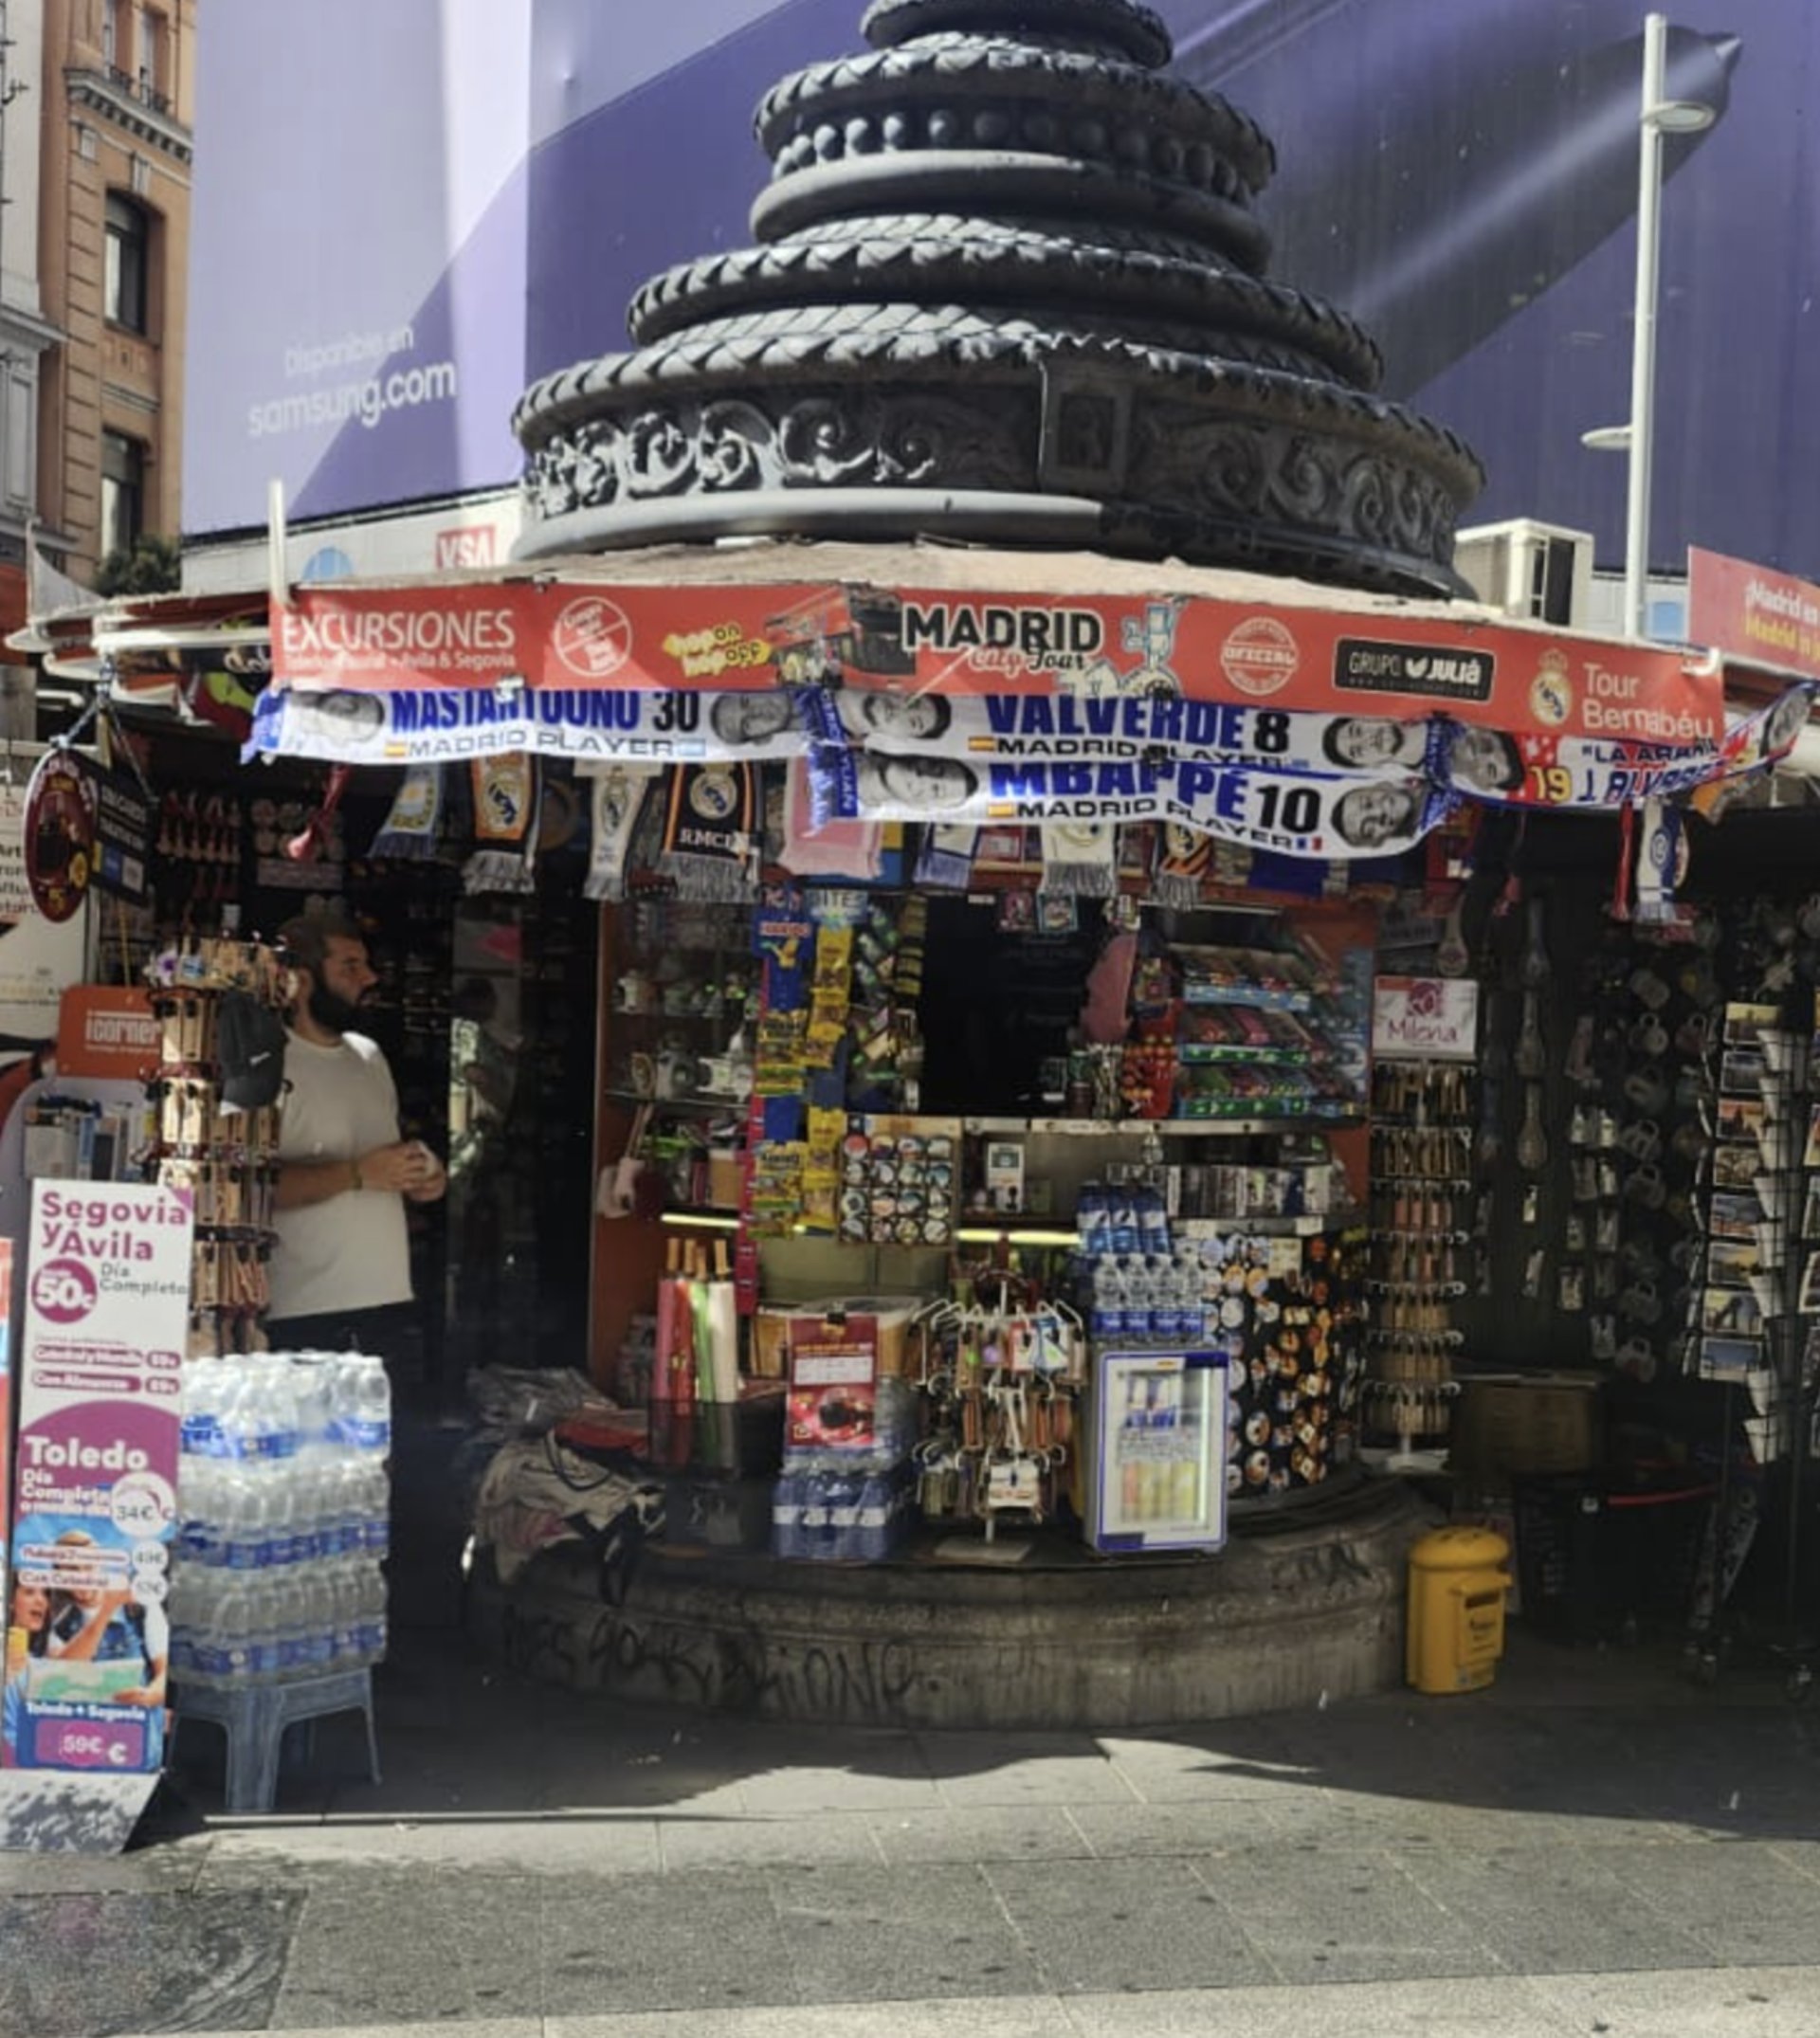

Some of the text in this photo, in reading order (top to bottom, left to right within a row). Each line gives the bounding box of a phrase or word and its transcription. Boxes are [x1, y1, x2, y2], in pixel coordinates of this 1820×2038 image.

[248, 360, 456, 436] samsung.com
[281, 608, 516, 652] EXCURSIONES
[903, 604, 1102, 656] MADRID
[454, 651, 515, 670] Segovia
[1028, 646, 1086, 670] Tour
[1349, 651, 1401, 678] GRUPO
[1582, 662, 1641, 701] Tour
[651, 689, 700, 734] 30
[984, 694, 1290, 754] VALVERDE 8
[1582, 698, 1714, 739] Bernabéu
[409, 729, 674, 757] MADRID PLAYER
[997, 737, 1138, 758] MADRID
[1530, 765, 1573, 804] 19
[1016, 797, 1295, 851] MADRID PLAYER
[1256, 784, 1322, 834] 10
[41, 1190, 188, 1229] Segovia
[100, 1280, 190, 1298] Completo
[24, 1435, 149, 1468] Toledo
